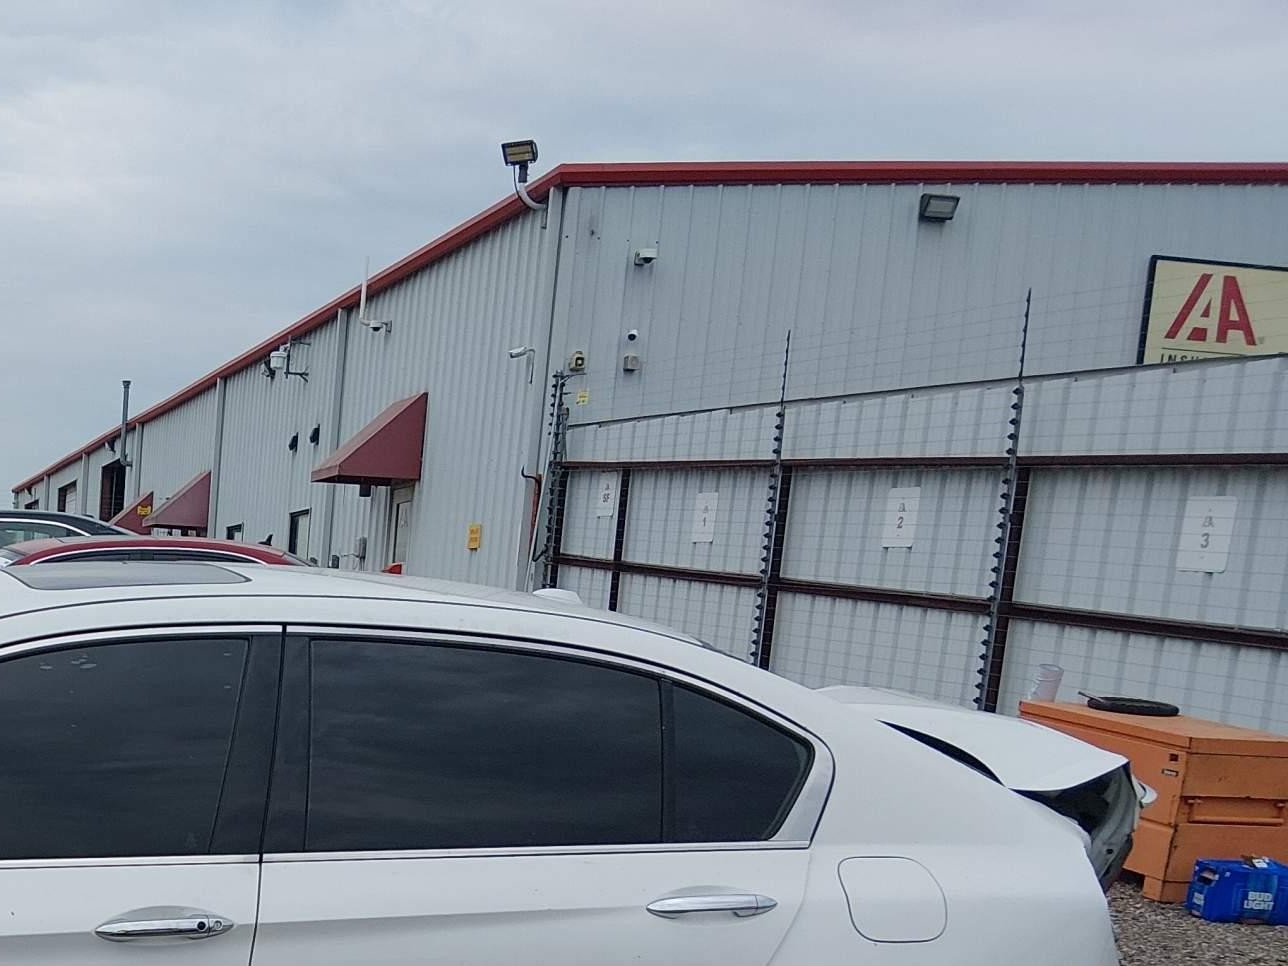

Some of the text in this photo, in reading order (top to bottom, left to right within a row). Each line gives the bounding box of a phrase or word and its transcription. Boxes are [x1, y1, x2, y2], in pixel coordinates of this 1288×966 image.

[896, 516, 904, 529] 2
[1200, 532, 1210, 549] 3
[1248, 891, 1272, 901] BUD
[1243, 900, 1274, 910] LIGHT
